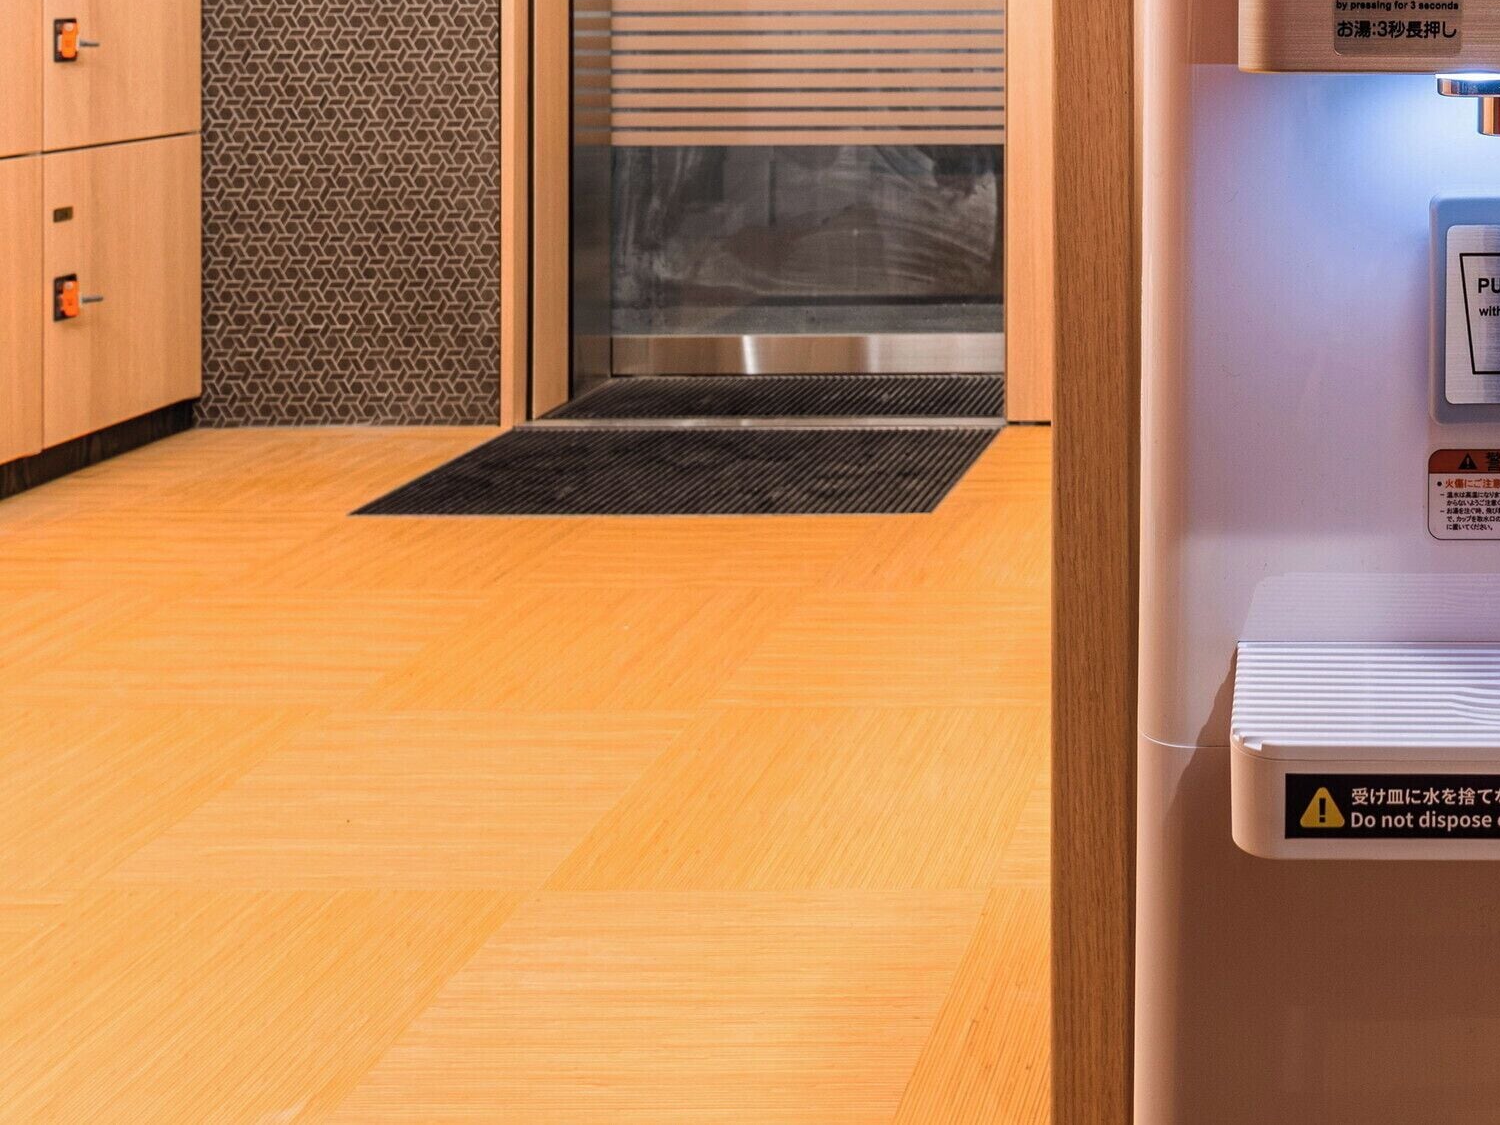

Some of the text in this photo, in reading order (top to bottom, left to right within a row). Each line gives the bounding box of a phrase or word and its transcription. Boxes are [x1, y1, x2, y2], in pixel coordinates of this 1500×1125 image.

[1336, 0, 1459, 12] by pressing for 3 seconds
[1336, 20, 1458, 39] お湯:3秒長押し
[1350, 811, 1377, 828] Do
[1381, 812, 1415, 828] not
[1418, 810, 1493, 832] dispose
